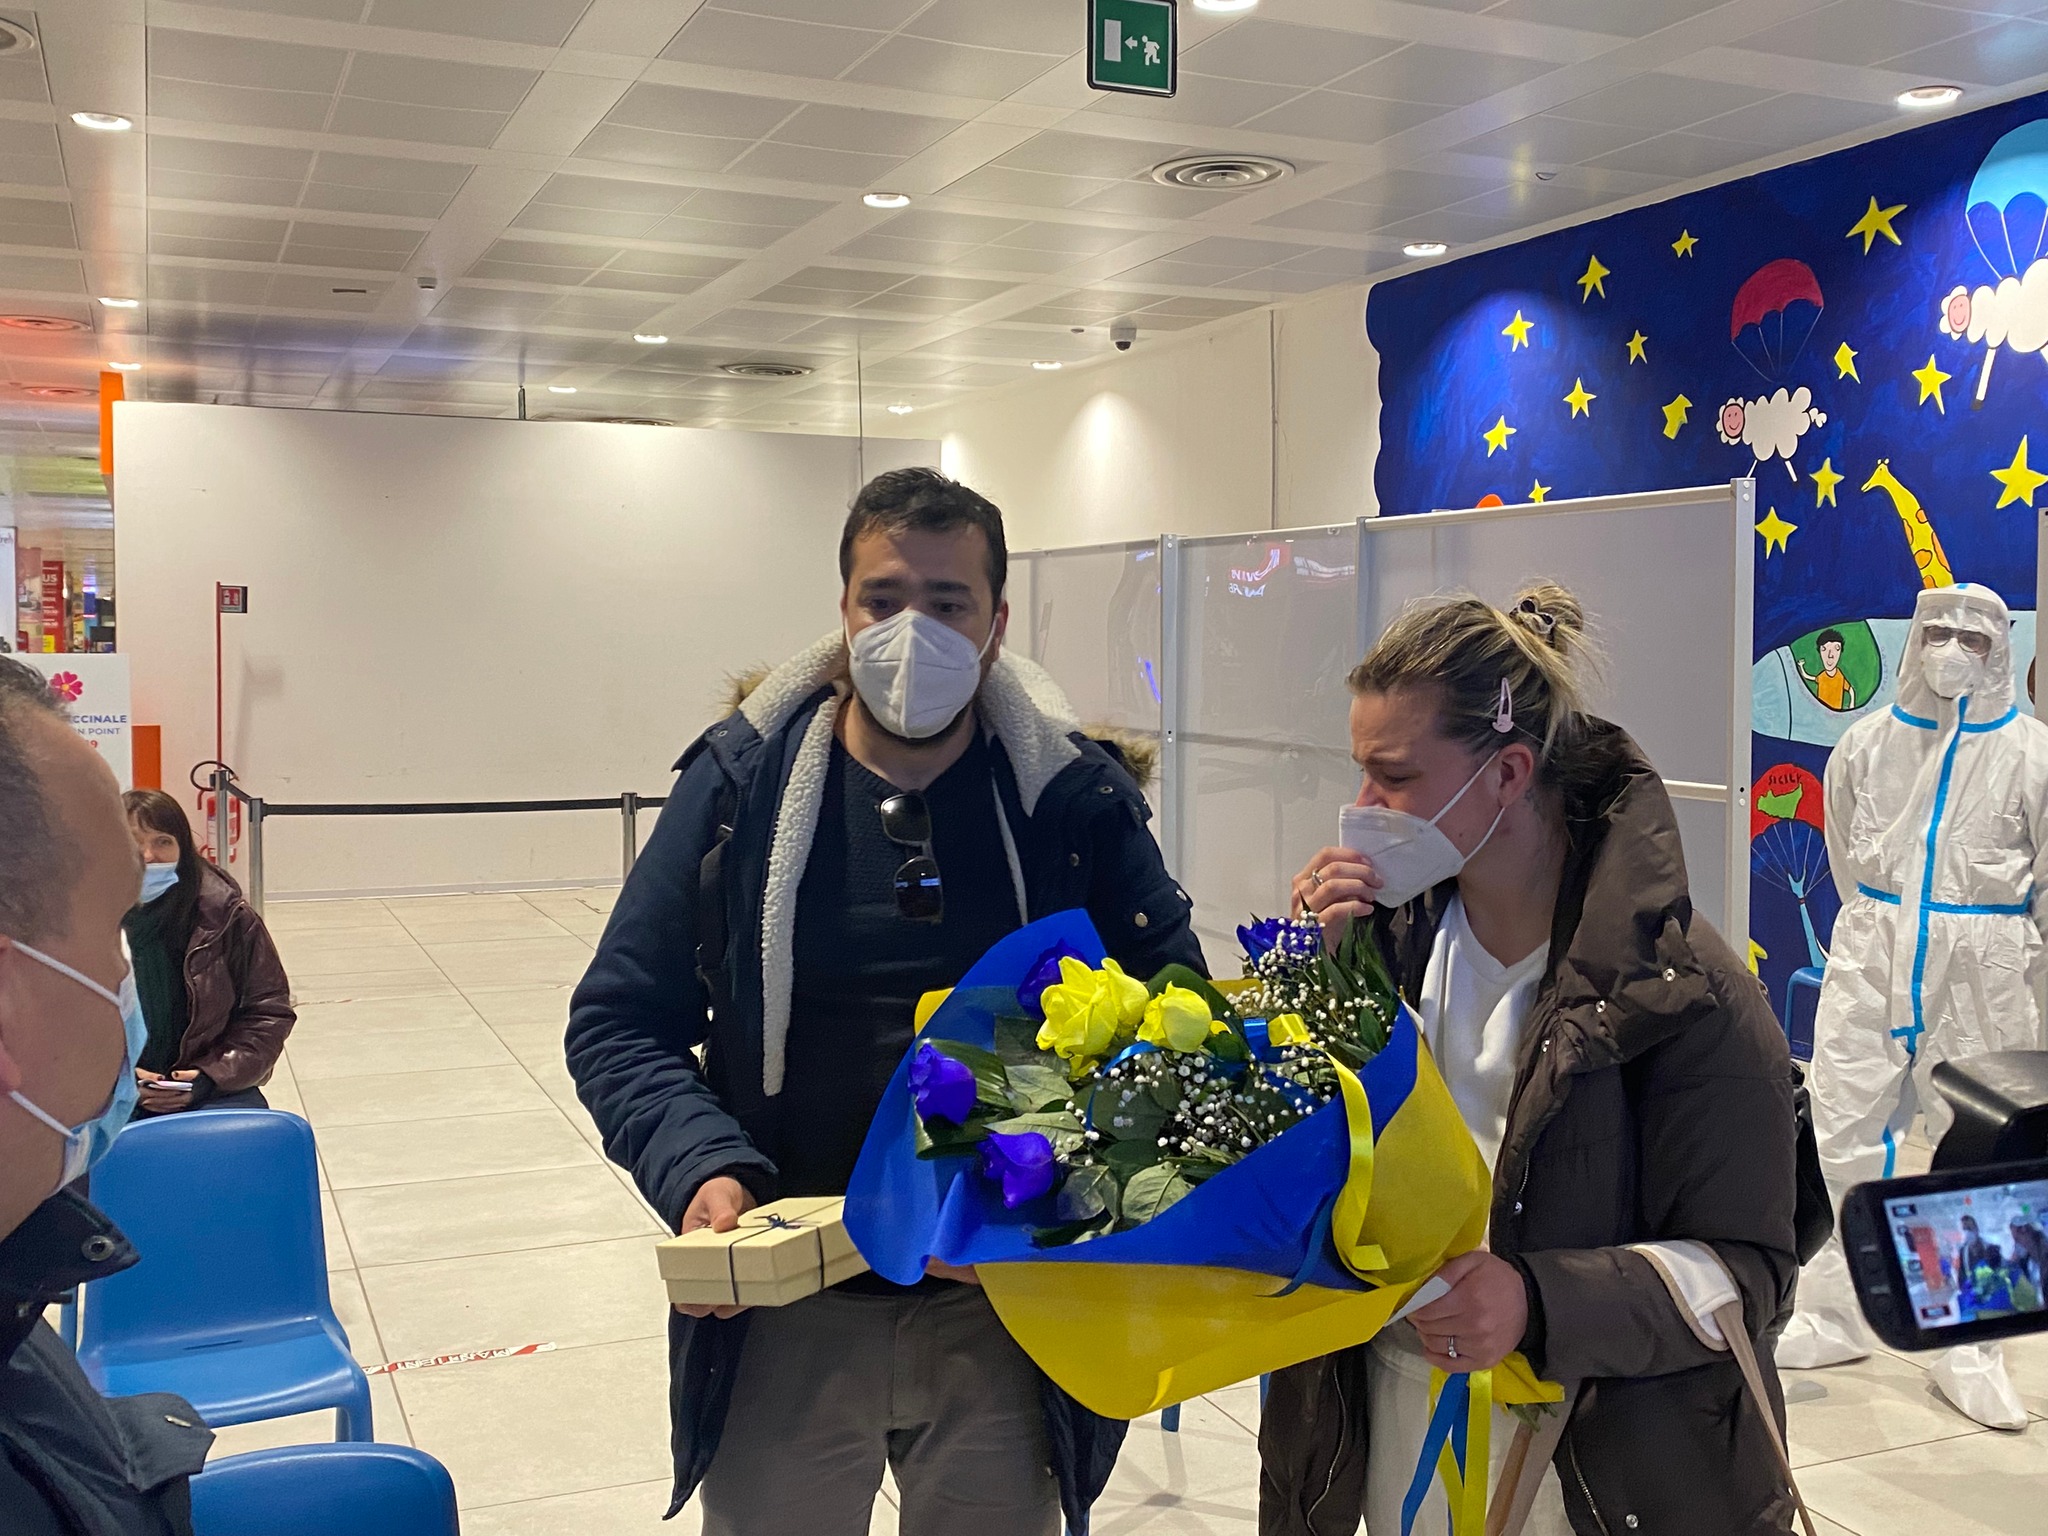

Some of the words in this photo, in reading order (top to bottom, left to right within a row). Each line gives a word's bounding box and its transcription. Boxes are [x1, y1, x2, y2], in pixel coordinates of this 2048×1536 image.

[72, 714, 127, 724] CCINALE
[88, 727, 120, 735] POINT
[1768, 772, 1802, 786] SICILY
